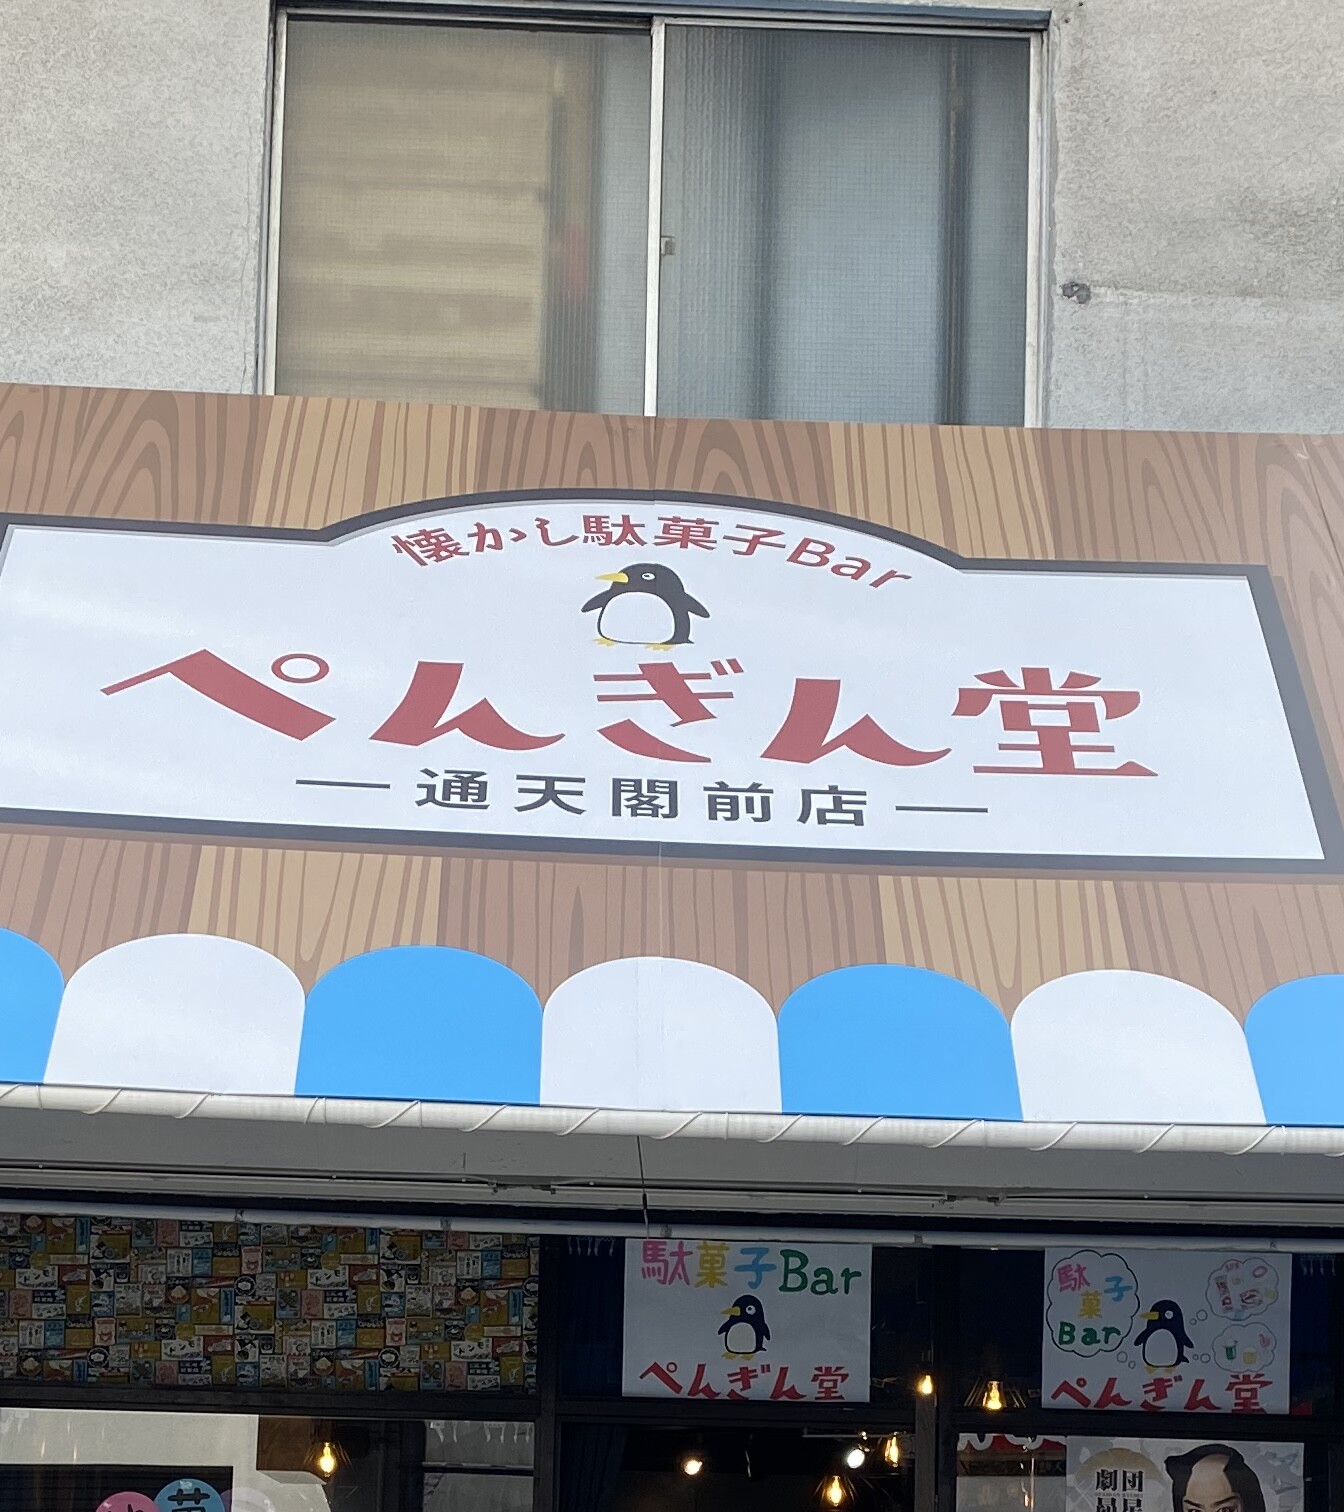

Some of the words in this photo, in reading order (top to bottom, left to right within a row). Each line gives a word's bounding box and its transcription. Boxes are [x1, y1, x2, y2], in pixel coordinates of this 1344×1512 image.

[391, 515, 913, 591] 懐かし駄菓子Bar
[101, 648, 1157, 778] ぺんぎん堂
[415, 767, 868, 829] 通天閣前店
[640, 1240, 863, 1297] 駄菓子Bar
[1057, 1321, 1122, 1348] Bar
[638, 1361, 851, 1402] ぺんぎん堂
[1050, 1373, 1274, 1414] ぺんぎん堂
[1095, 1469, 1144, 1493] 劇団
